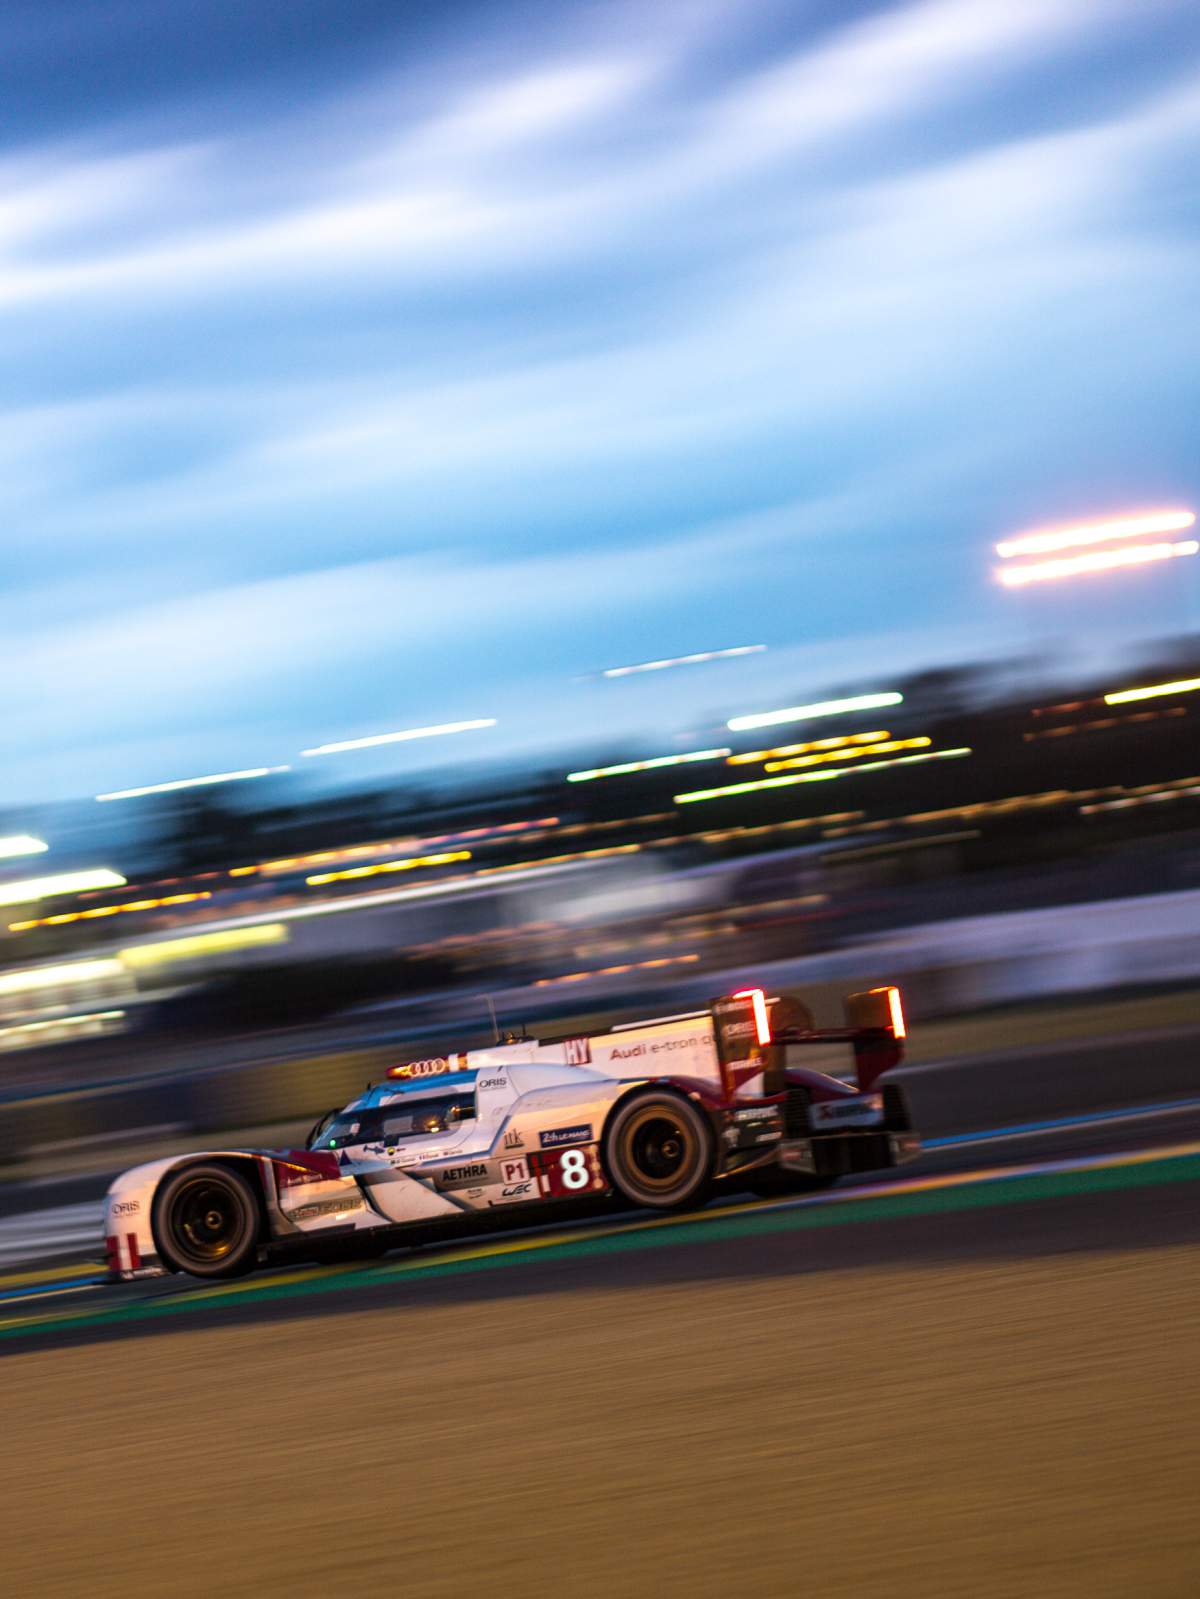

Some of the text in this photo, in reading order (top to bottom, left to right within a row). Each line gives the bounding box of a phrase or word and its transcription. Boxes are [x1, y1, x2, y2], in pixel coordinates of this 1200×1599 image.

[564, 1037, 591, 1066] HY
[610, 1043, 648, 1061] Audi
[650, 1037, 698, 1054] e-tron
[479, 1077, 507, 1089] ORIS
[442, 1163, 488, 1181] AETHRA
[504, 1162, 525, 1181] P1
[560, 1149, 590, 1189] 8
[502, 1183, 532, 1196] WEC
[111, 1200, 141, 1215] ORIS
